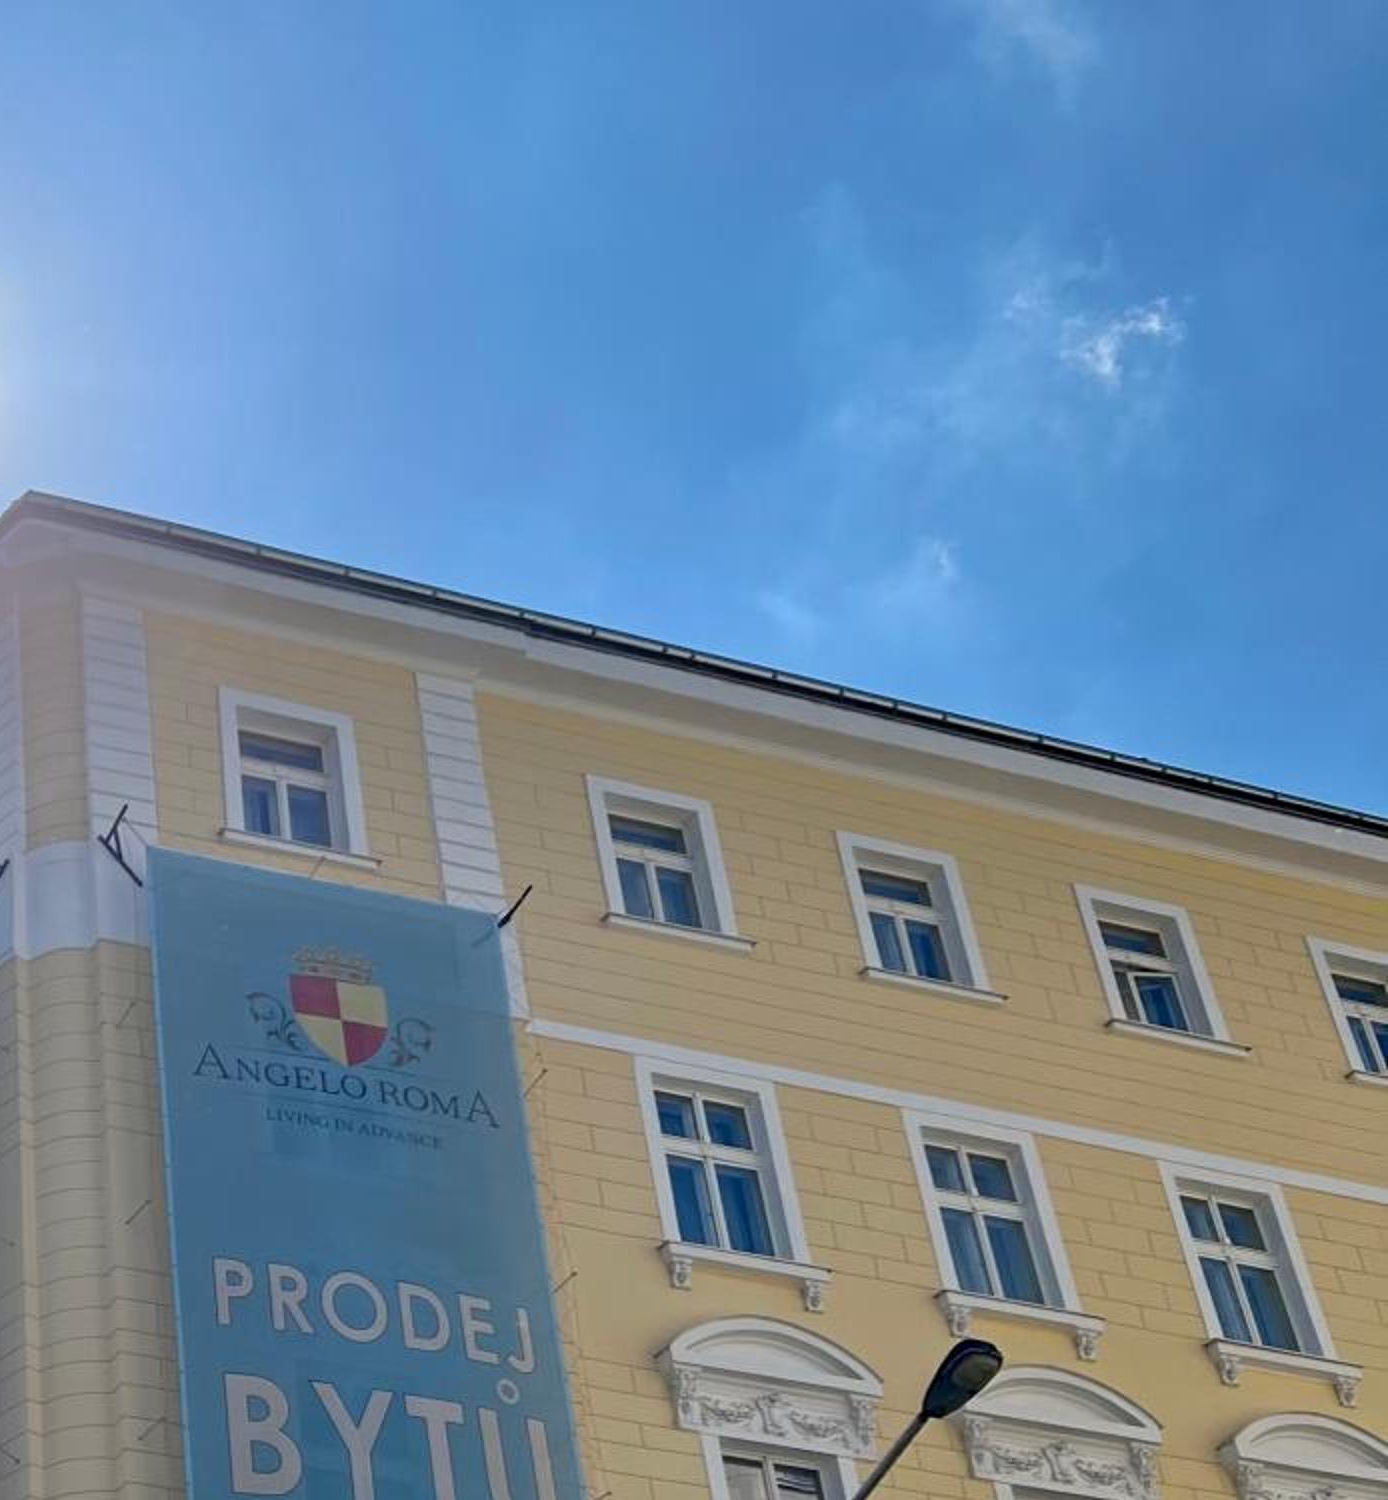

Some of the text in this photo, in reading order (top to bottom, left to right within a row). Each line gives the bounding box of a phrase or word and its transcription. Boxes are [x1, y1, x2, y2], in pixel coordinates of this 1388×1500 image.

[266, 1107, 329, 1129] LIVING
[358, 1122, 443, 1150] ADVANCE
[213, 1256, 536, 1373] PRODEJ
